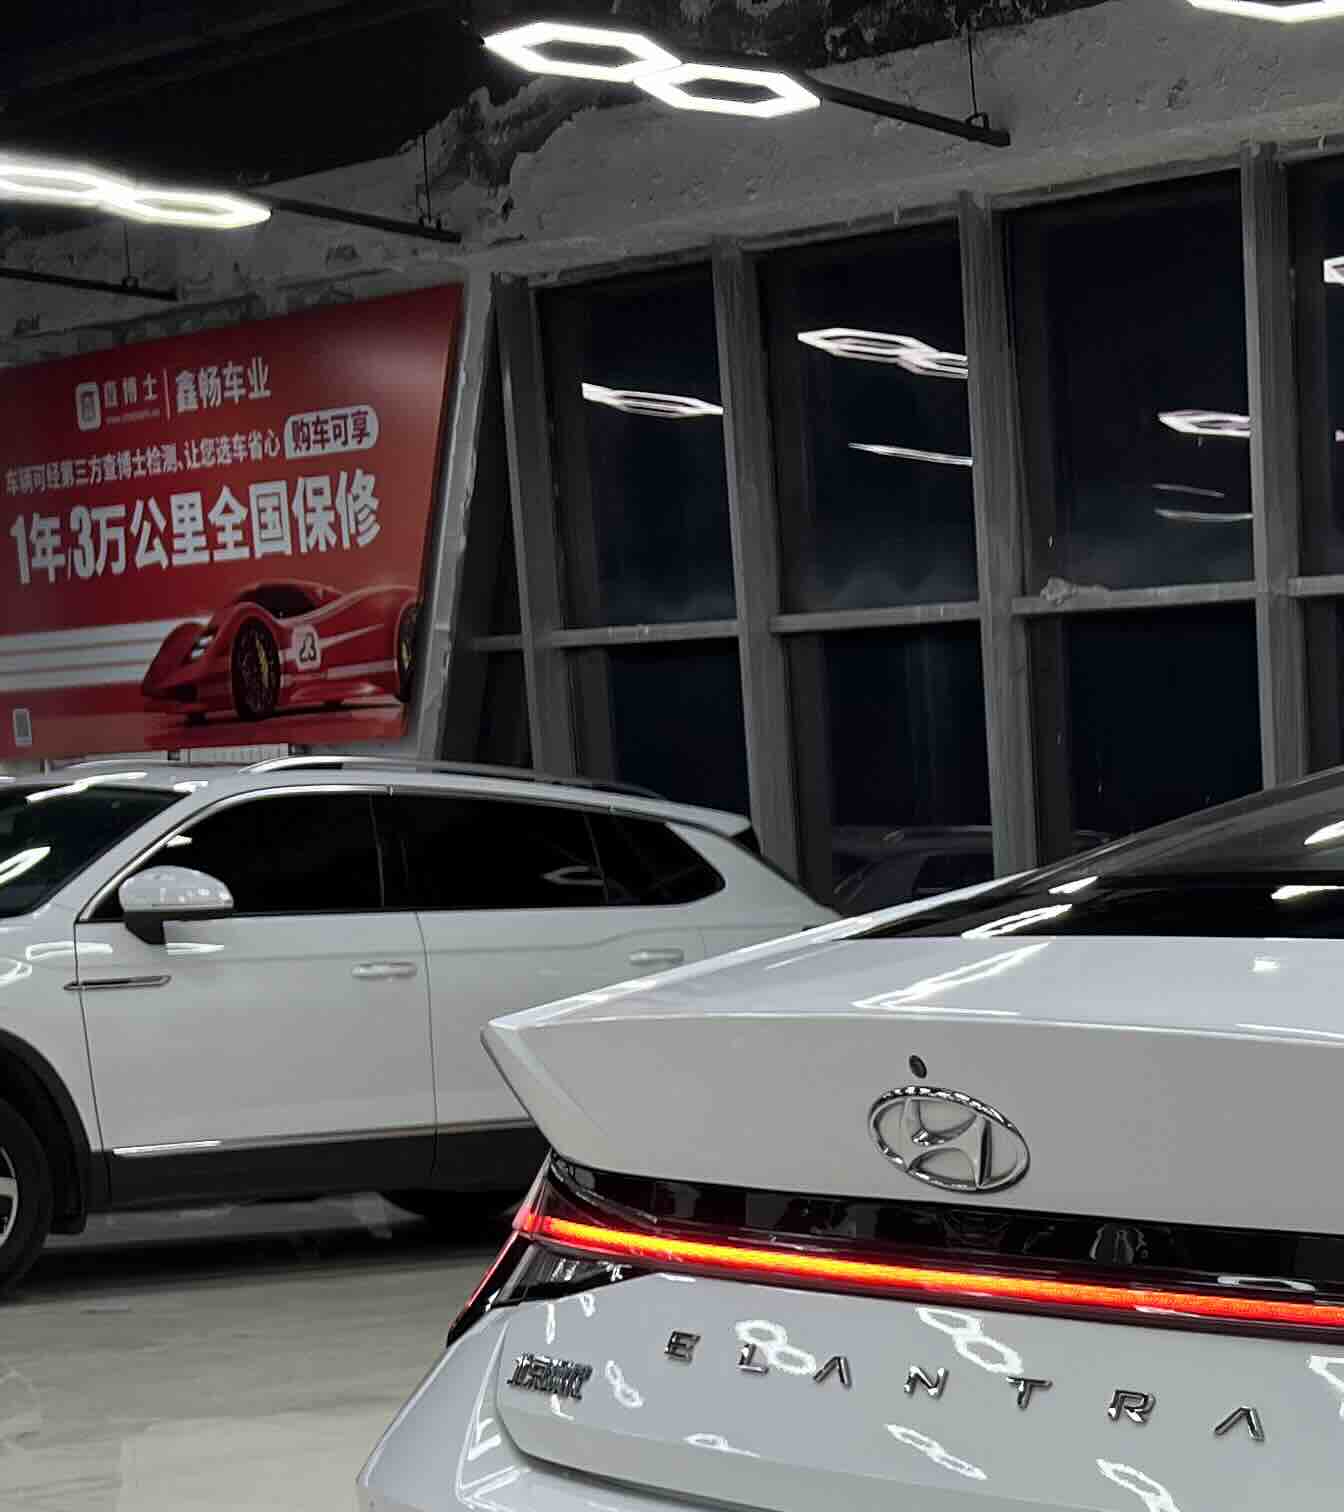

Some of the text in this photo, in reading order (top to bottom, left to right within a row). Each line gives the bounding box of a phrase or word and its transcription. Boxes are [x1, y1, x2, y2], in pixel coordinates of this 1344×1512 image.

[176, 357, 271, 413] 鑫畅车业
[292, 411, 371, 453] 购车可享
[664, 1330, 1264, 1442] ELANTRA
